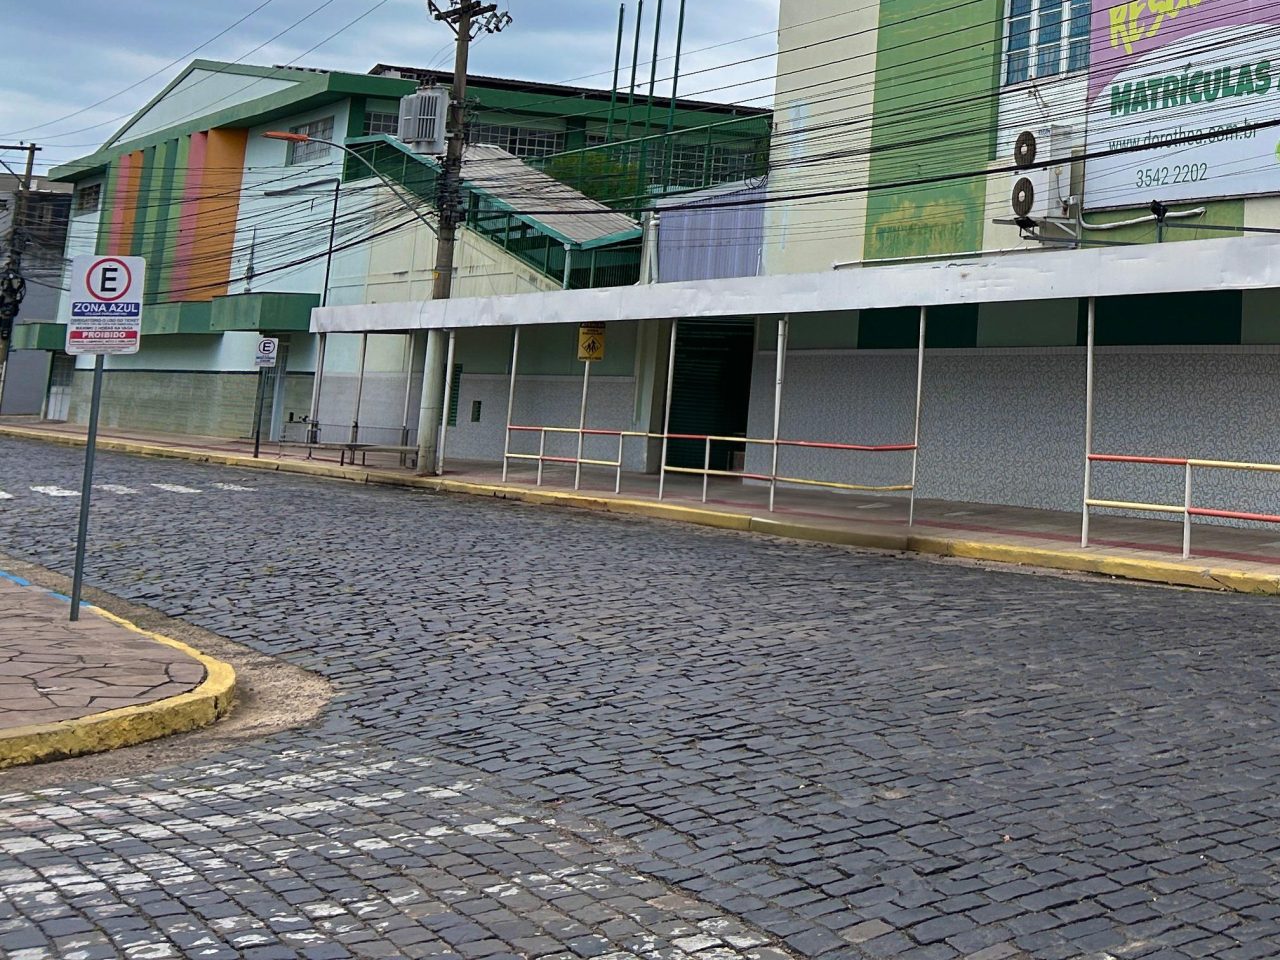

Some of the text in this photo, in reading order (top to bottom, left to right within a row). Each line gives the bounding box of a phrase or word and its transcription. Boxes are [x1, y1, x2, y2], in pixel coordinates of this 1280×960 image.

[1110, 59, 1272, 116] MATRÍCULAS
[1108, 117, 1257, 152] wwwdorothea.com.br
[1136, 163, 1208, 188] 3542 2202
[100, 267, 118, 292] E
[74, 303, 138, 313] ZONA AZUL
[262, 342, 271, 352] E
